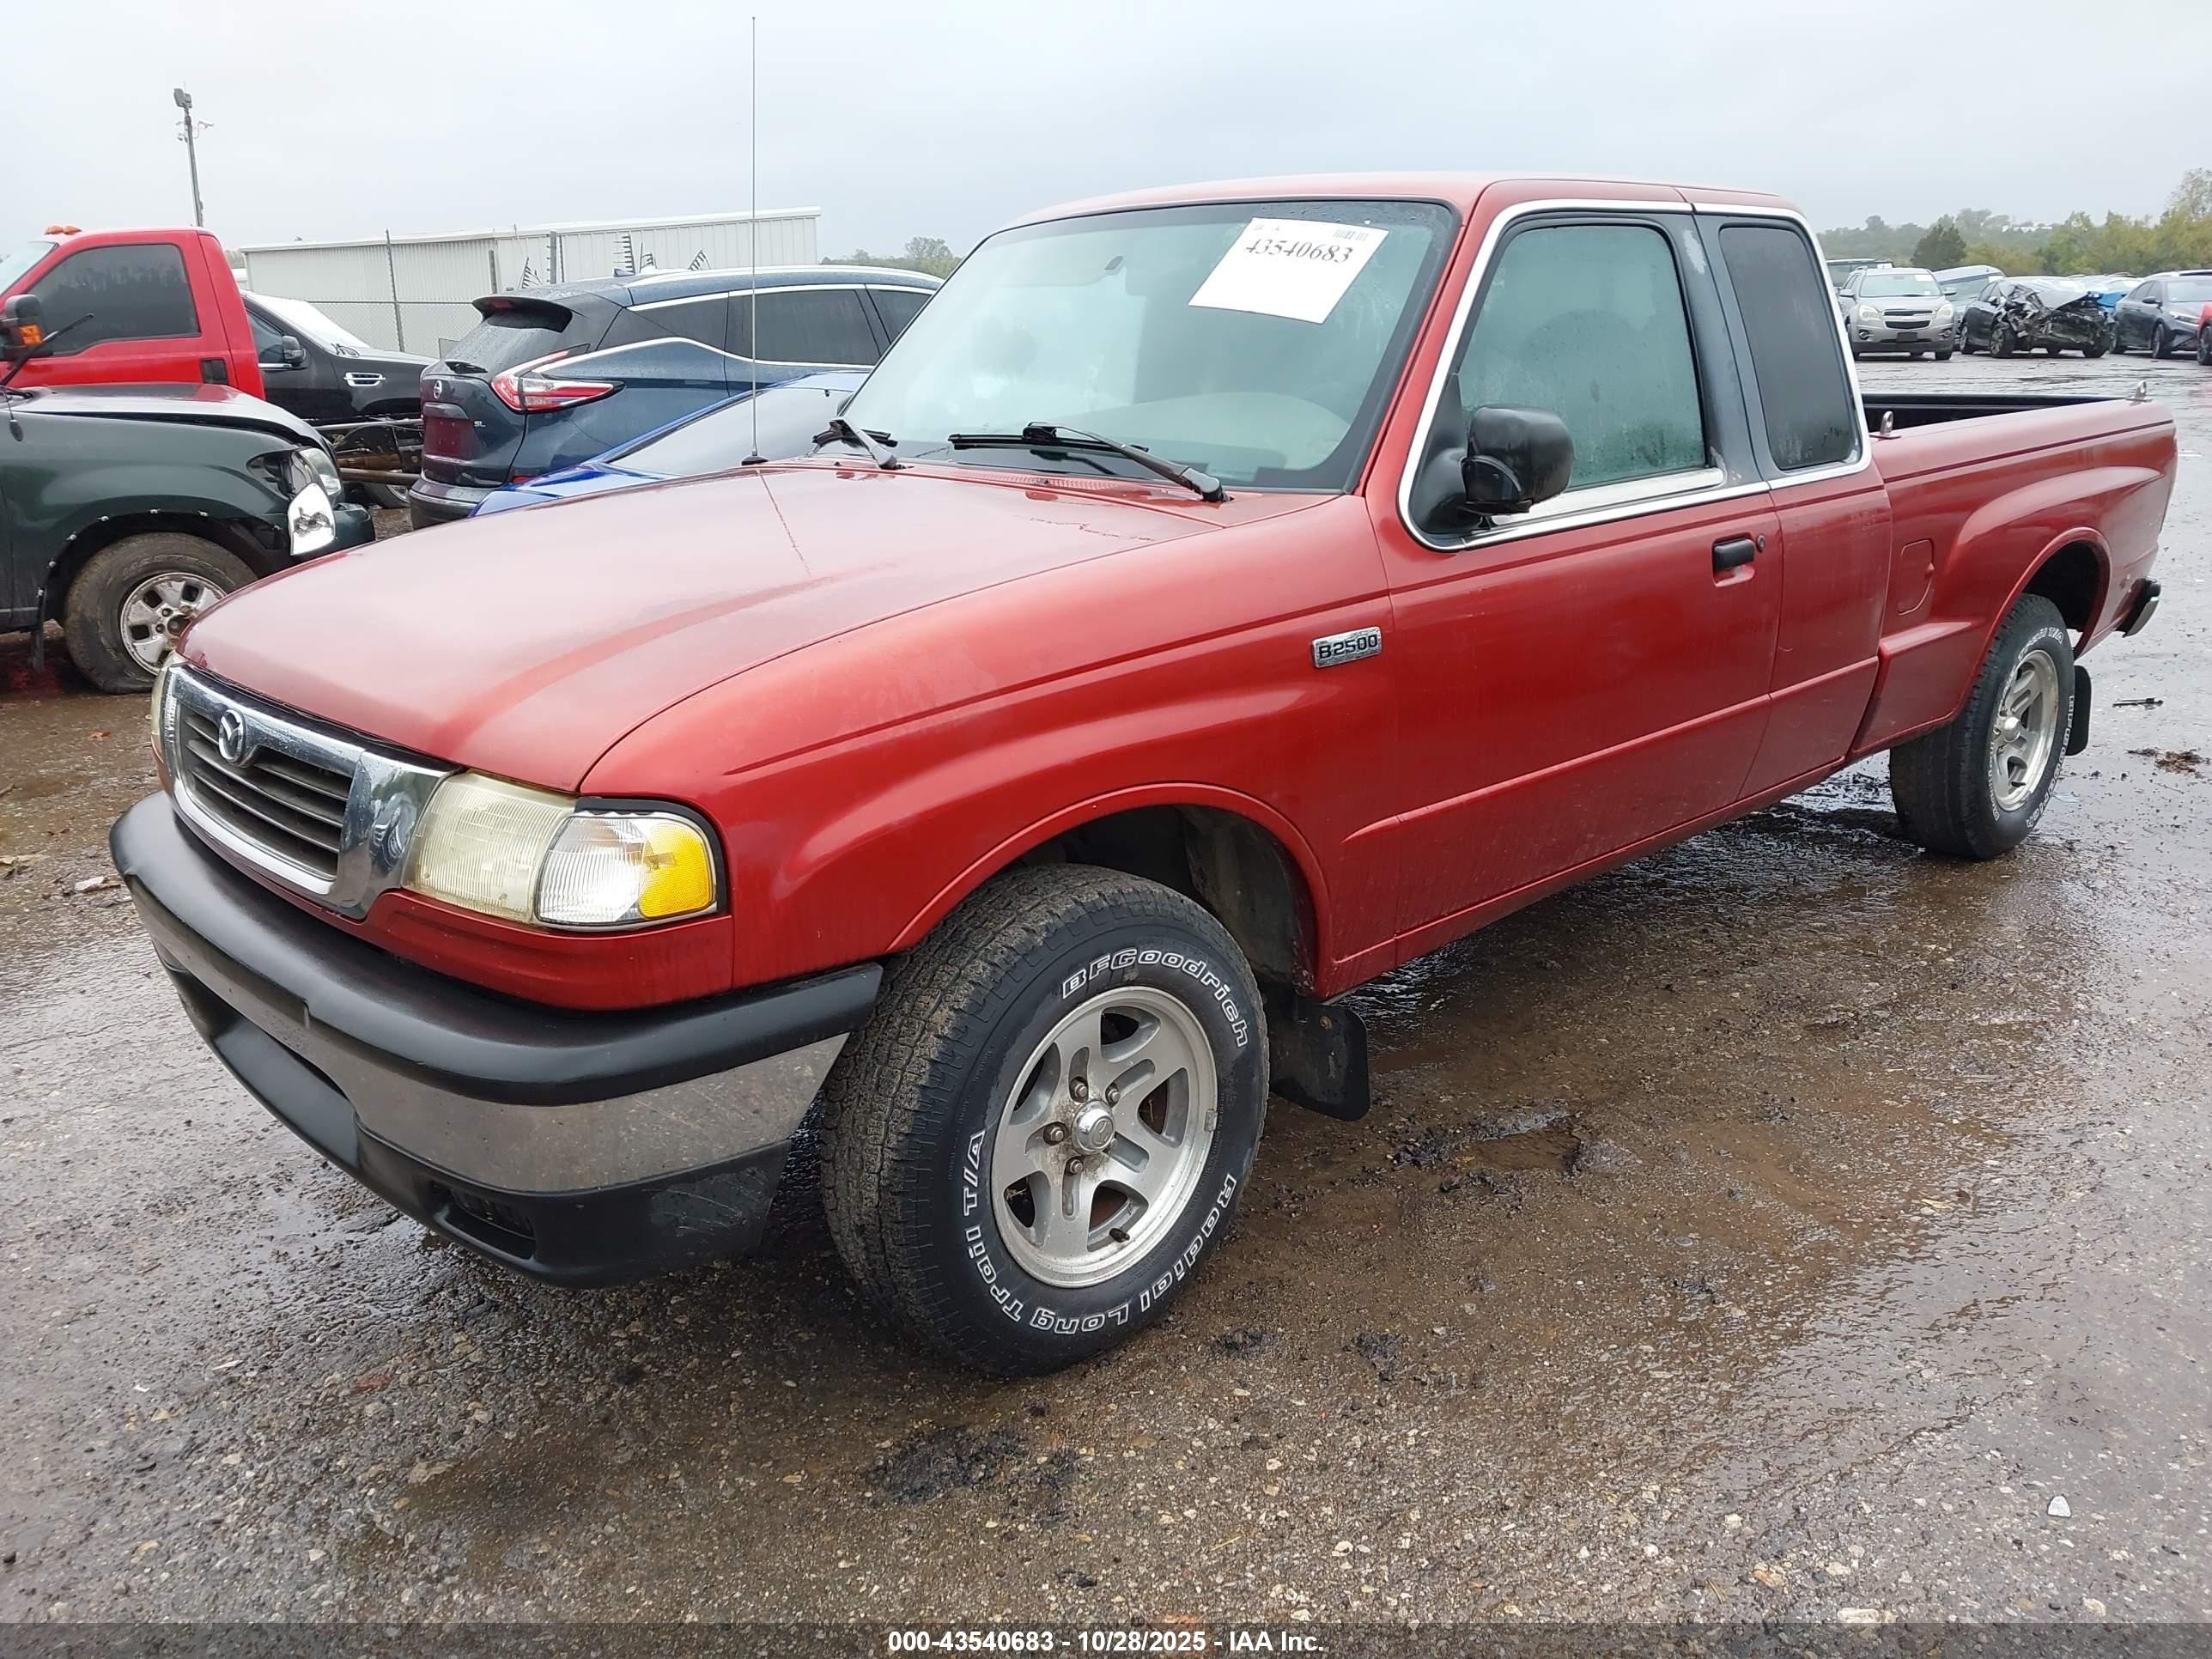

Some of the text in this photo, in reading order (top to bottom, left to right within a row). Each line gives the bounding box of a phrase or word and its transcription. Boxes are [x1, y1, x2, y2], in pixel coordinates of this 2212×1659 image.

[1245, 238, 1354, 264] 43540683
[1318, 634, 1378, 659] B2500
[1061, 947, 1249, 1048] BFGoodrich
[963, 1129, 986, 1216] T/A
[964, 1224, 1024, 1322] Trail
[1139, 1173, 1238, 1313] Radial
[1030, 1303, 1130, 1334] Long
